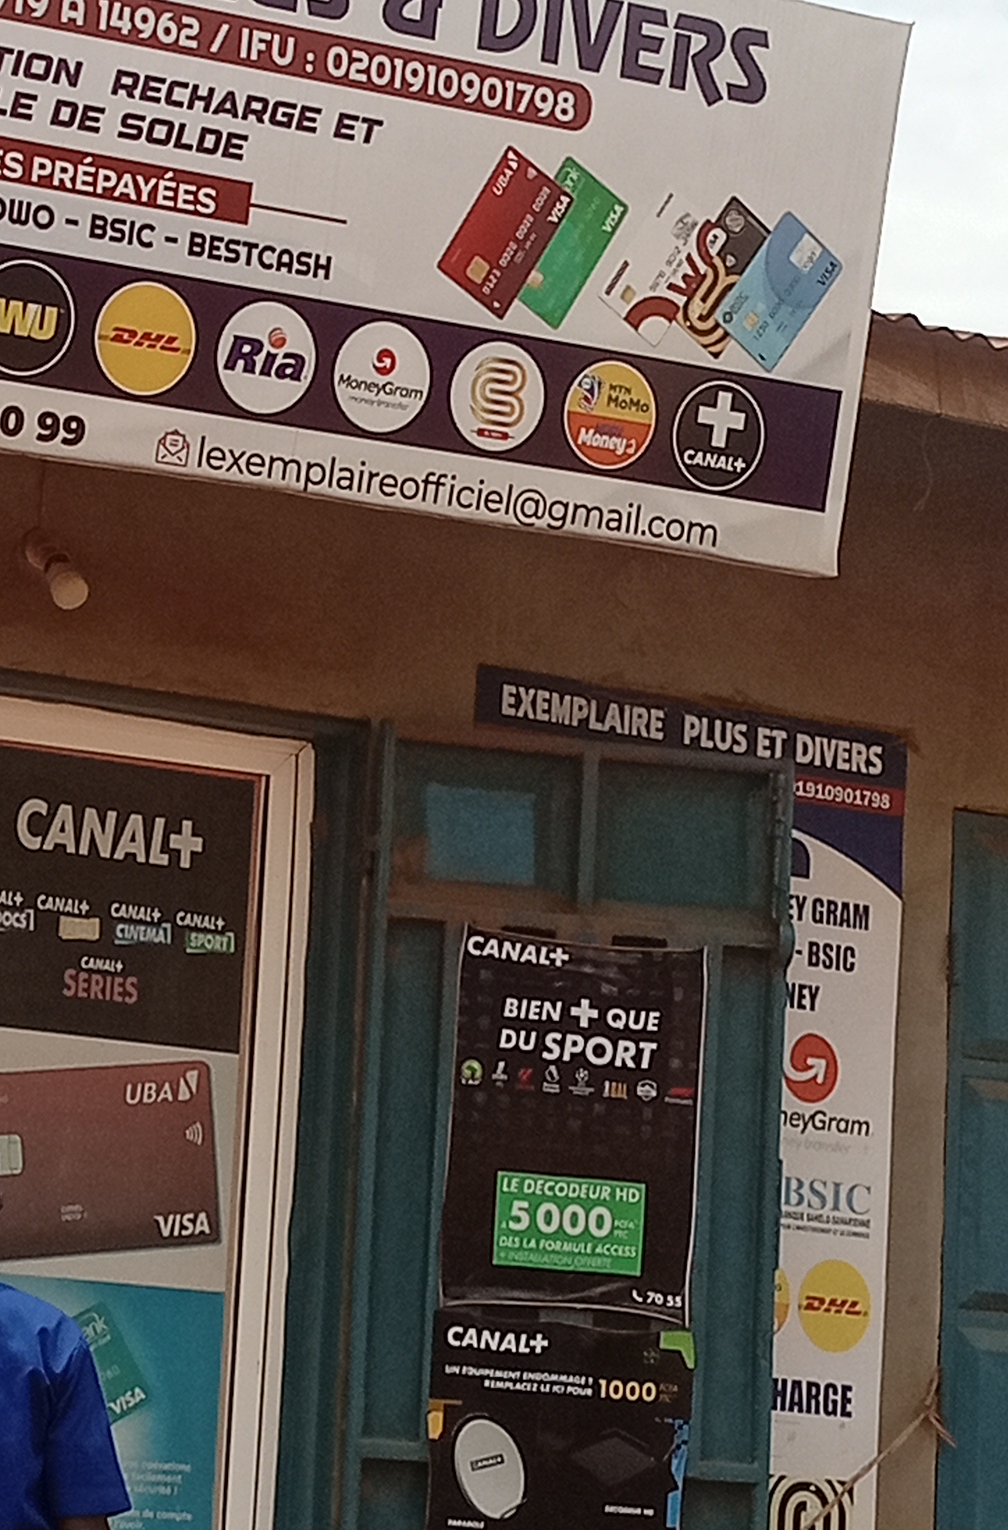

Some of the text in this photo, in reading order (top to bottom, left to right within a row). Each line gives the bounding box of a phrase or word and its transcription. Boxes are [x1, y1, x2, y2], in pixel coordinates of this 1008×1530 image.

[208, 22, 229, 57] /
[238, 28, 296, 69] IFU
[326, 44, 578, 124] 0201910901798
[111, 69, 320, 135] RECHARGE
[334, 113, 385, 147] ET
[50, 92, 107, 134] DE
[117, 110, 249, 162] SOLDE
[30, 151, 218, 216] PRÉPAYÉES
[547, 195, 571, 225] VISA
[601, 203, 625, 234] VISA
[88, 217, 156, 250] BSIC
[188, 226, 332, 281] BESTCASH
[108, 325, 182, 355] DHL
[224, 327, 306, 383] Ria
[338, 373, 423, 401] MoneyGram
[607, 393, 649, 413] MoMo
[36, 411, 86, 447] 99
[683, 448, 746, 474] CANAL+
[197, 435, 717, 548] lexemplaireofficiel@gmail.com
[501, 683, 884, 776] EXEMPLAIRE PLUS ET DIVERS
[16, 797, 203, 869] CANAL+
[37, 894, 89, 915] CANAL+
[111, 902, 161, 923] CANAL+
[811, 897, 870, 931] GRAM
[176, 911, 225, 931] CANAL+
[189, 933, 229, 953] SPORT
[467, 936, 569, 967] CANAL+
[807, 941, 856, 973] BSIC
[80, 955, 124, 973] CANAL+
[503, 997, 562, 1021] BIEN
[606, 1008, 661, 1032] QUE
[499, 1028, 658, 1069] DU SPORT
[125, 1082, 173, 1105] UBA
[782, 1109, 870, 1136] neyGram
[502, 1177, 520, 1193] LE
[616, 1187, 640, 1203] HD
[783, 1176, 871, 1215] BSIC
[154, 1211, 210, 1238] VISA
[539, 1239, 592, 1255] FORMULE
[596, 1244, 637, 1258] ACCESS
[646, 1291, 664, 1305] 70
[803, 1295, 865, 1317] DHL
[447, 1325, 549, 1354] CANAL+
[108, 1386, 146, 1415] VISA
[598, 1377, 658, 1402] 1000
[772, 1377, 853, 1418] HARGE
